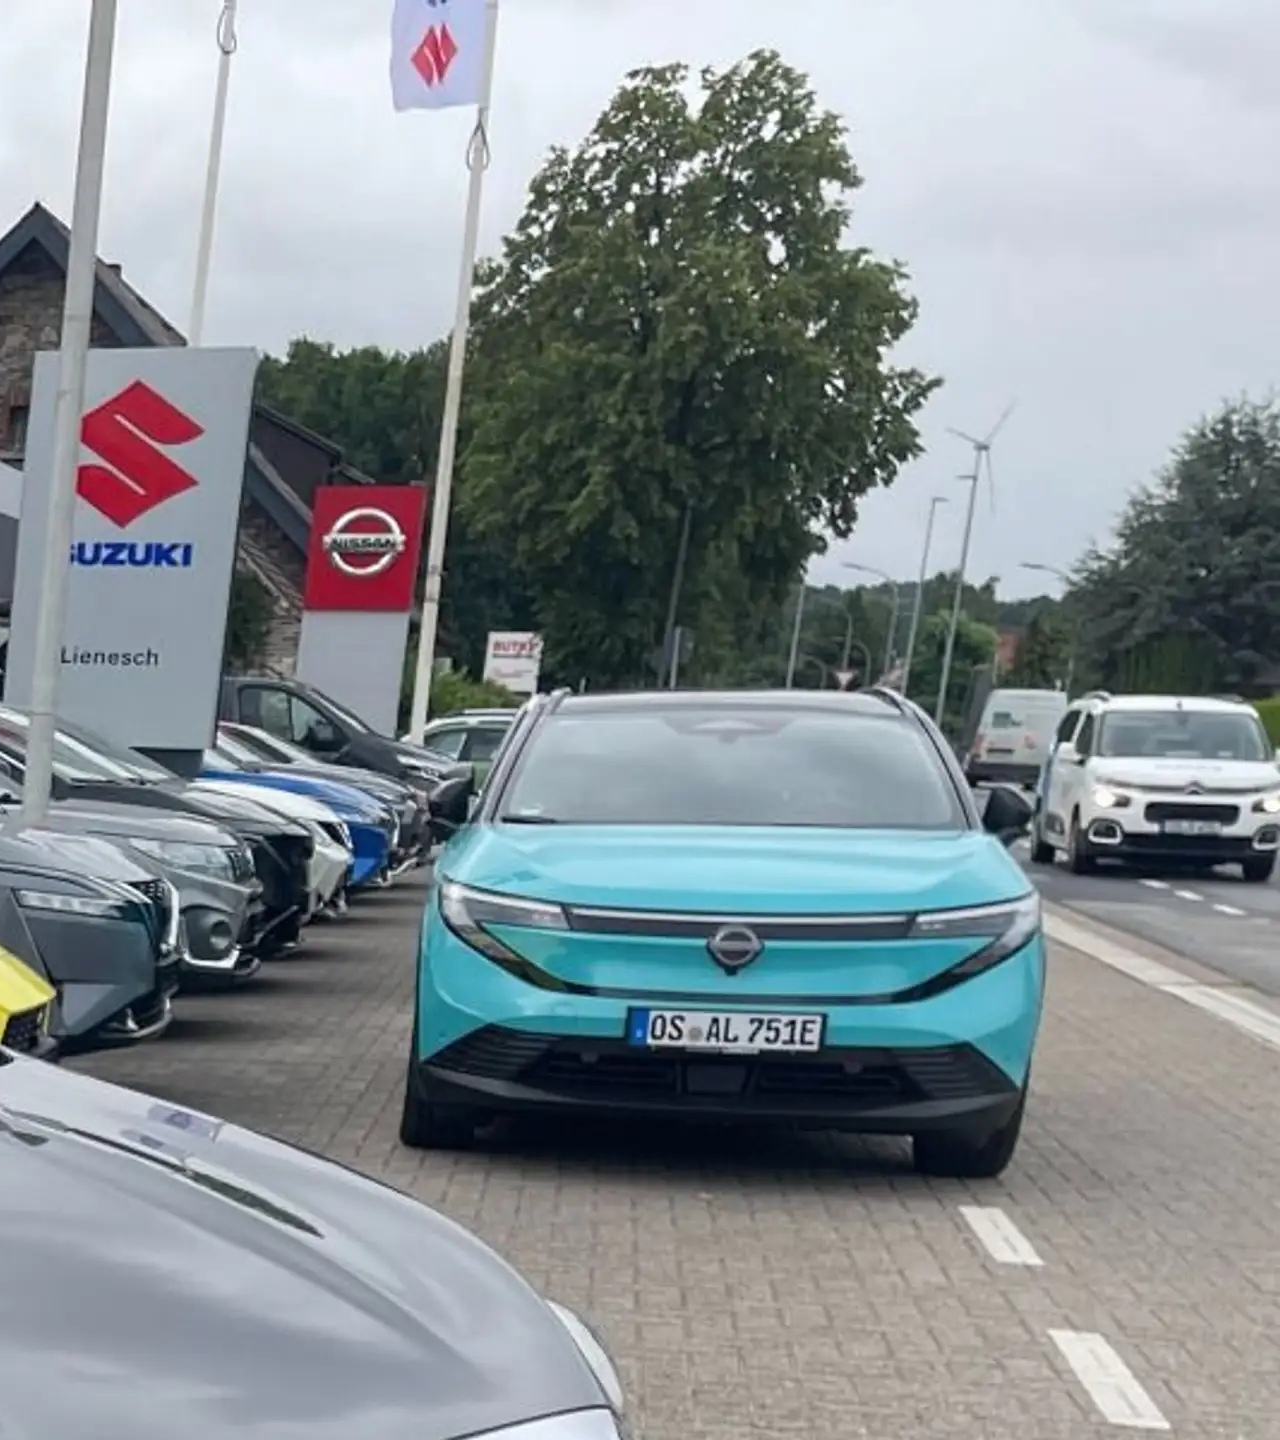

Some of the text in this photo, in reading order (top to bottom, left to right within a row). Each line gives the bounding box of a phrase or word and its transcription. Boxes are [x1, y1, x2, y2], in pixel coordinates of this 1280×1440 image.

[330, 537, 397, 552] NISSAN
[60, 646, 159, 667] Lienesch
[651, 1014, 817, 1046] OS AL 751E
